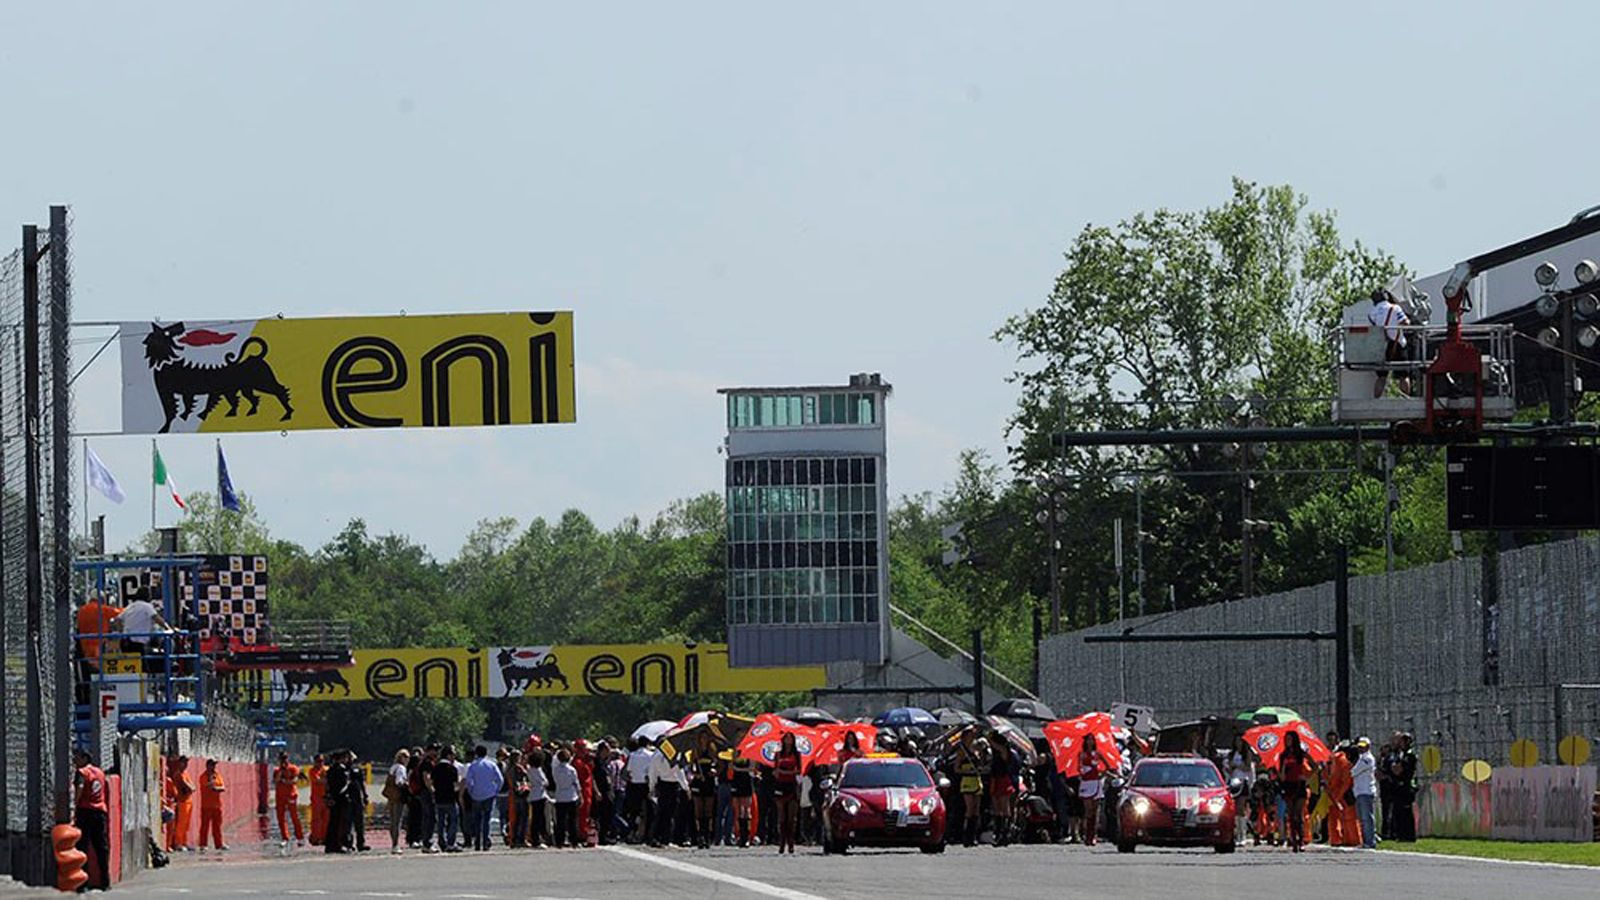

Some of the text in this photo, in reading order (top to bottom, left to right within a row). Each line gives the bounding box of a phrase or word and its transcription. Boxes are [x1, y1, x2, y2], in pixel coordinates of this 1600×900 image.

[322, 312, 559, 428] eni
[365, 648, 481, 699] eni
[583, 644, 699, 696] eni
[102, 695, 116, 718] F
